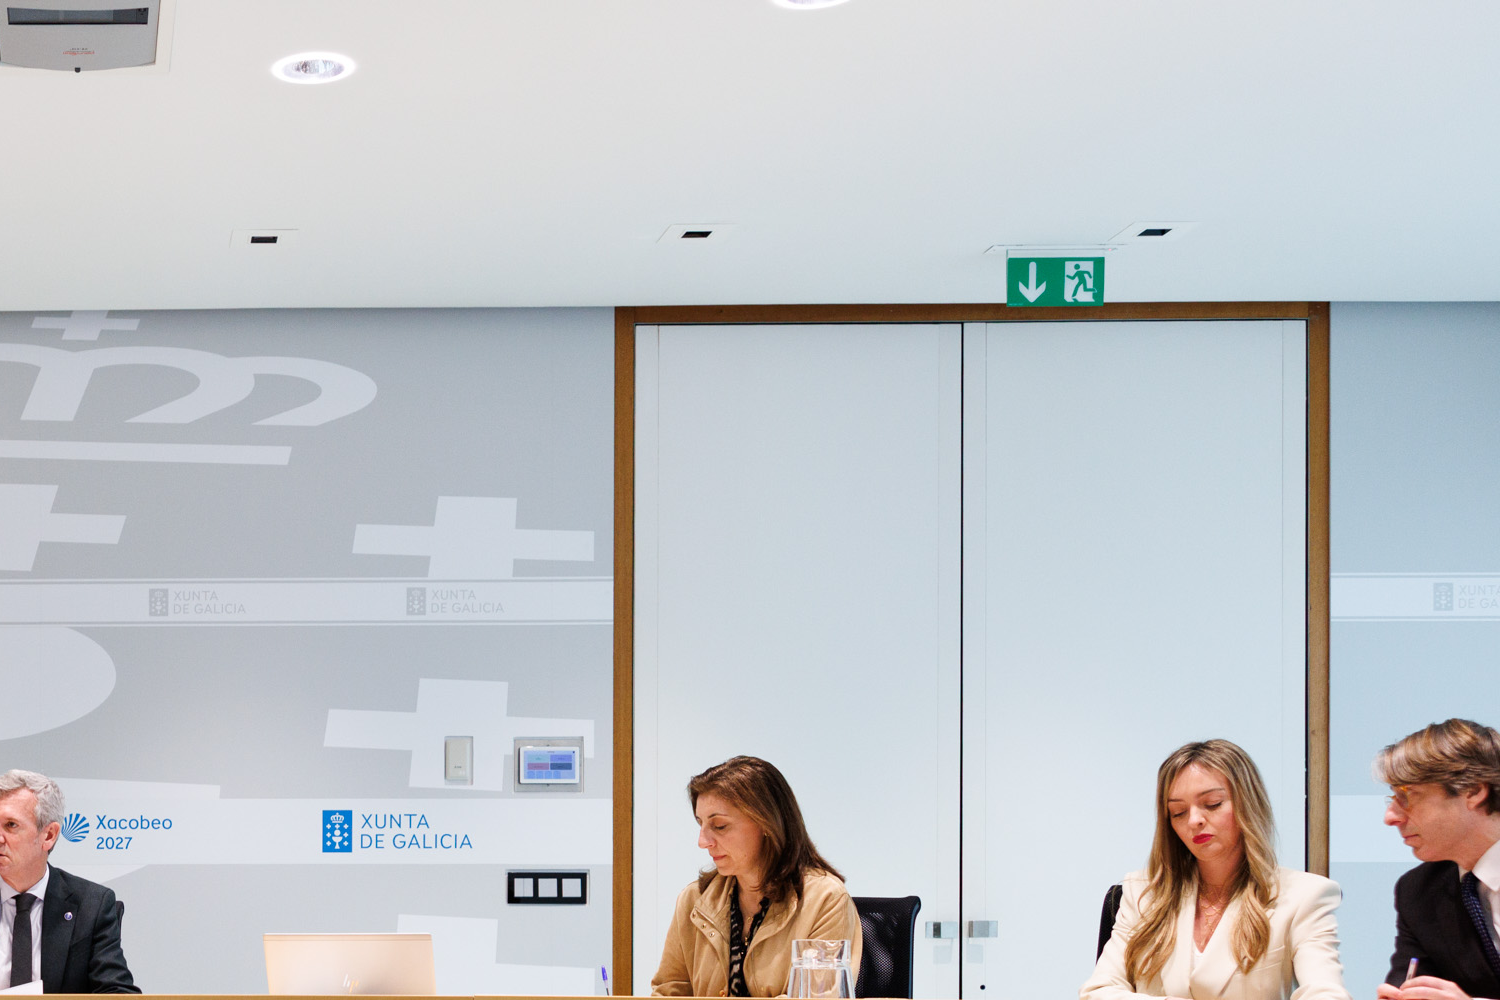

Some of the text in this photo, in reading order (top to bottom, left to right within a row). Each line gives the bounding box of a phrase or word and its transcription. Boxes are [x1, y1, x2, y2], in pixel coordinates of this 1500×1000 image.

[173, 590, 219, 601] XUNTA
[431, 589, 477, 600] XUNTA
[173, 603, 246, 614] DE GALICIA
[430, 602, 505, 613] DE GALICIA
[95, 814, 173, 830] Xacobeo
[361, 813, 430, 829] XUNTA
[96, 836, 133, 850] 2027
[360, 833, 473, 849] DE GALICIA
